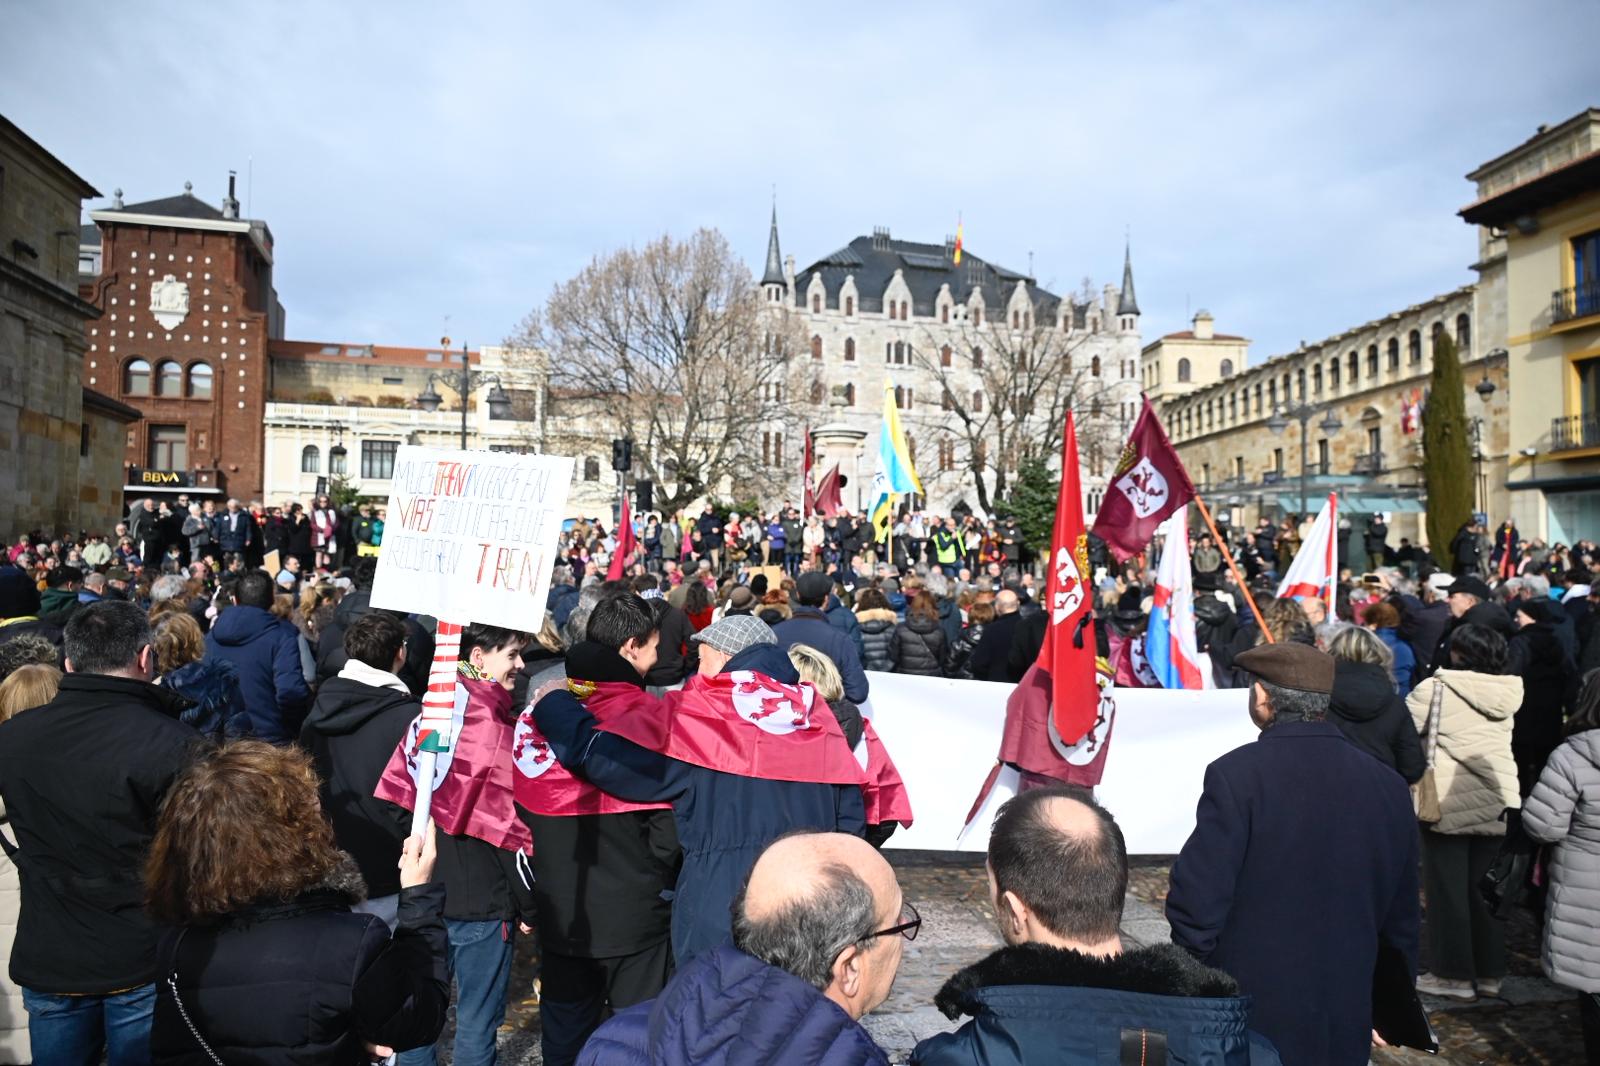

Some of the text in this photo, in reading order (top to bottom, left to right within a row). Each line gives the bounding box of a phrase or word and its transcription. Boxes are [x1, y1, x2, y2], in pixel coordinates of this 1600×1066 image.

[142, 471, 180, 483] BBVA
[519, 467, 551, 504] EN
[475, 542, 544, 597] TREN
